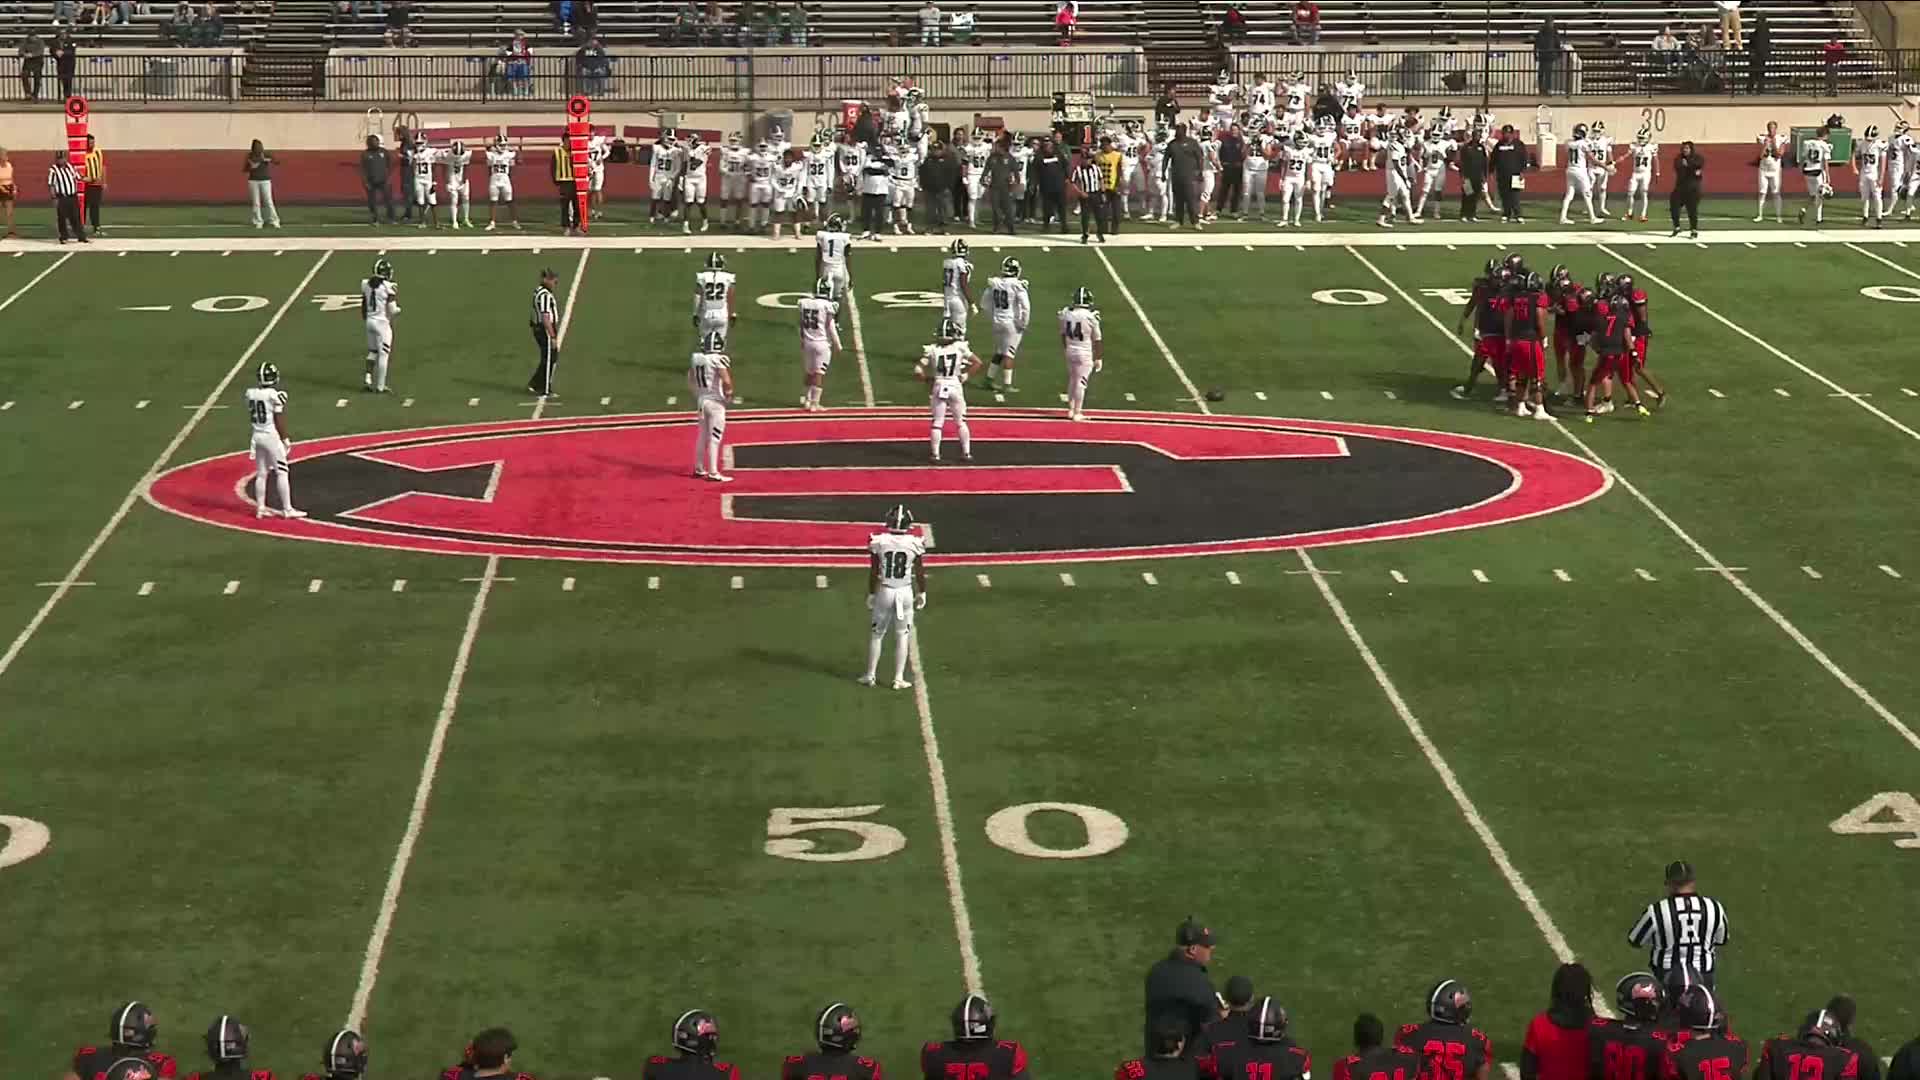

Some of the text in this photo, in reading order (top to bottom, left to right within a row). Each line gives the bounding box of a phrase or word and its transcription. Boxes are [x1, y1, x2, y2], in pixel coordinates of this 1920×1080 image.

[1252, 94, 1265, 105] 74
[1641, 107, 1666, 132] 30
[810, 163, 824, 176] 32
[1288, 160, 1303, 171] 23
[828, 239, 835, 258] 1
[704, 282, 724, 301] 22
[1065, 321, 1083, 342] 44
[1605, 315, 1617, 337] 7
[936, 353, 957, 377] 47
[695, 365, 708, 389] 11
[883, 550, 908, 580] 18
[1678, 912, 1702, 945] H
